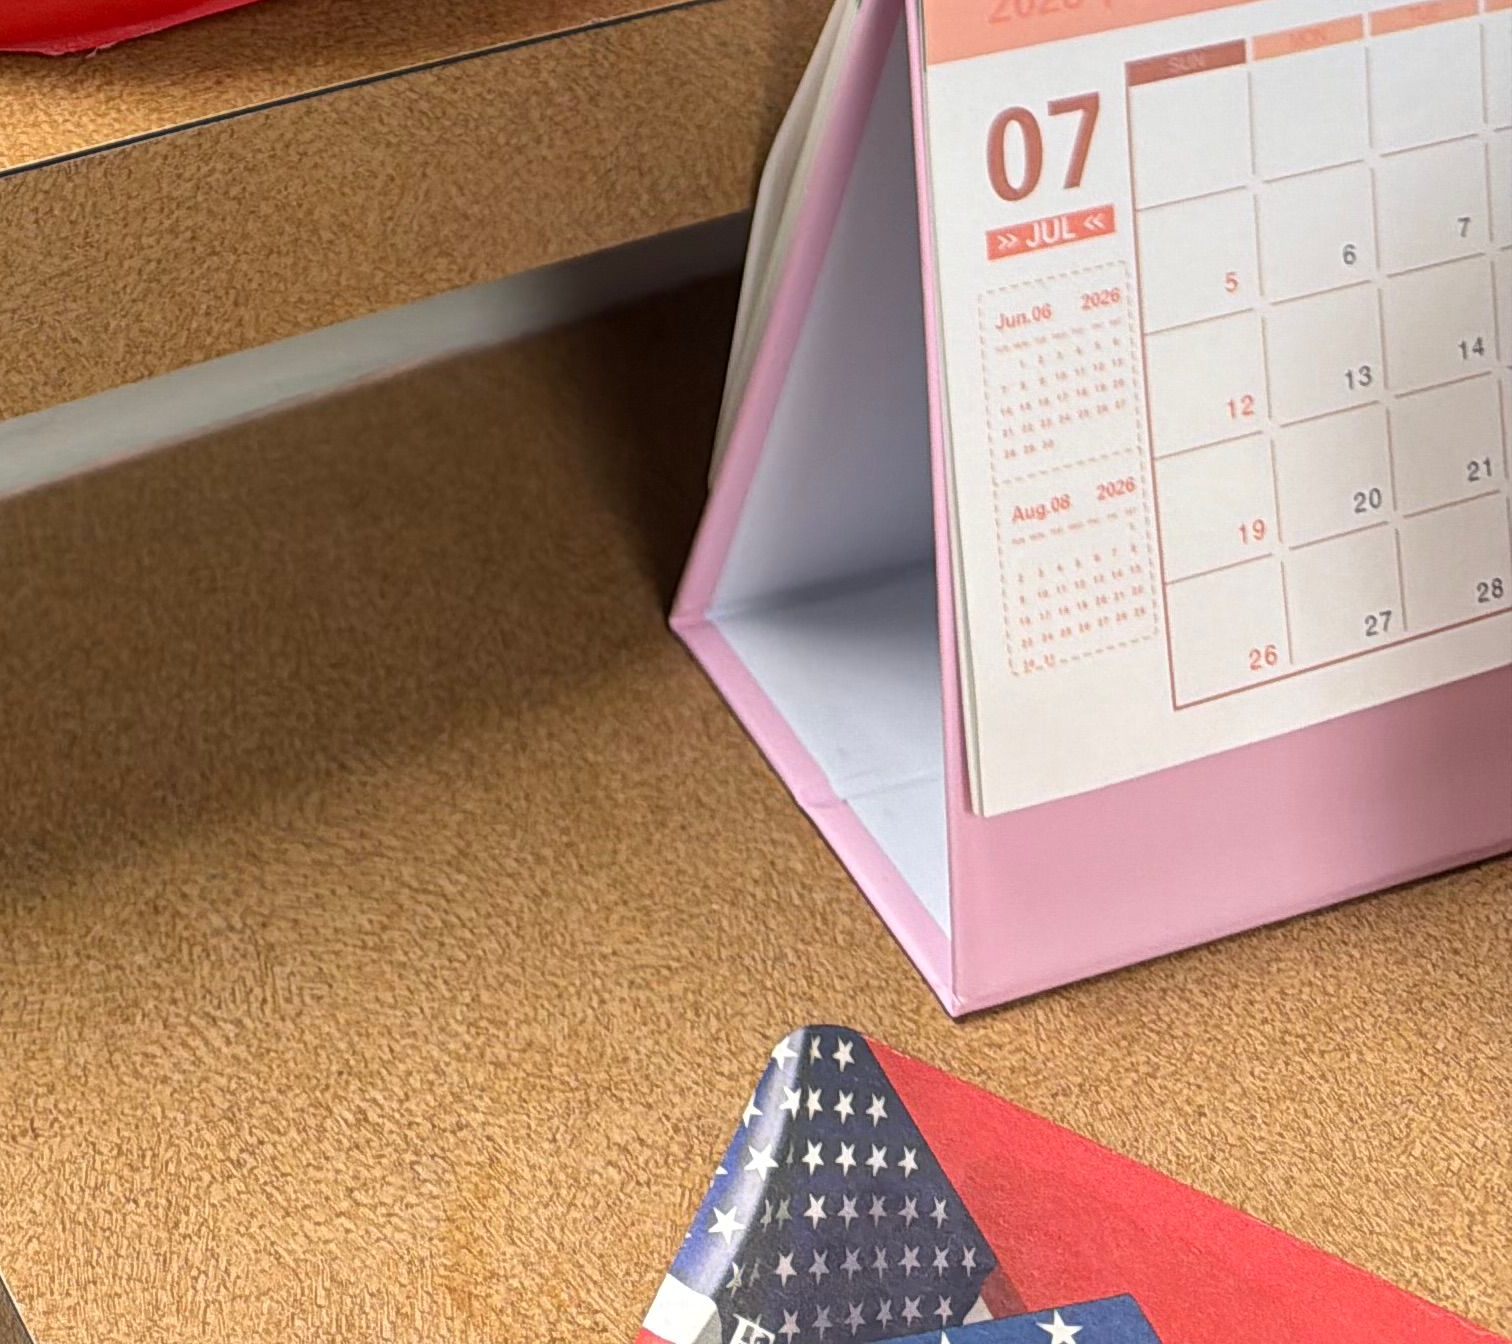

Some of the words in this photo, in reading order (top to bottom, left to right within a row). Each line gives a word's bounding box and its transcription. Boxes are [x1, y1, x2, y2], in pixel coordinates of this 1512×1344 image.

[986, 91, 1100, 202] 07
[1025, 216, 1077, 249] JUL
[1457, 217, 1471, 238] 7
[1342, 244, 1357, 265] 6
[1224, 272, 1239, 293] 5
[1081, 287, 1121, 311] 2026
[1458, 337, 1484, 360] 14
[1344, 365, 1372, 390] 13
[1227, 394, 1255, 419] 12
[1467, 457, 1492, 482] 21
[1096, 476, 1136, 501] 2026
[1353, 487, 1382, 514] 20
[1240, 518, 1266, 545] 19
[1476, 577, 1504, 603] 28
[1364, 610, 1392, 637] 27
[1249, 644, 1278, 671] 26
